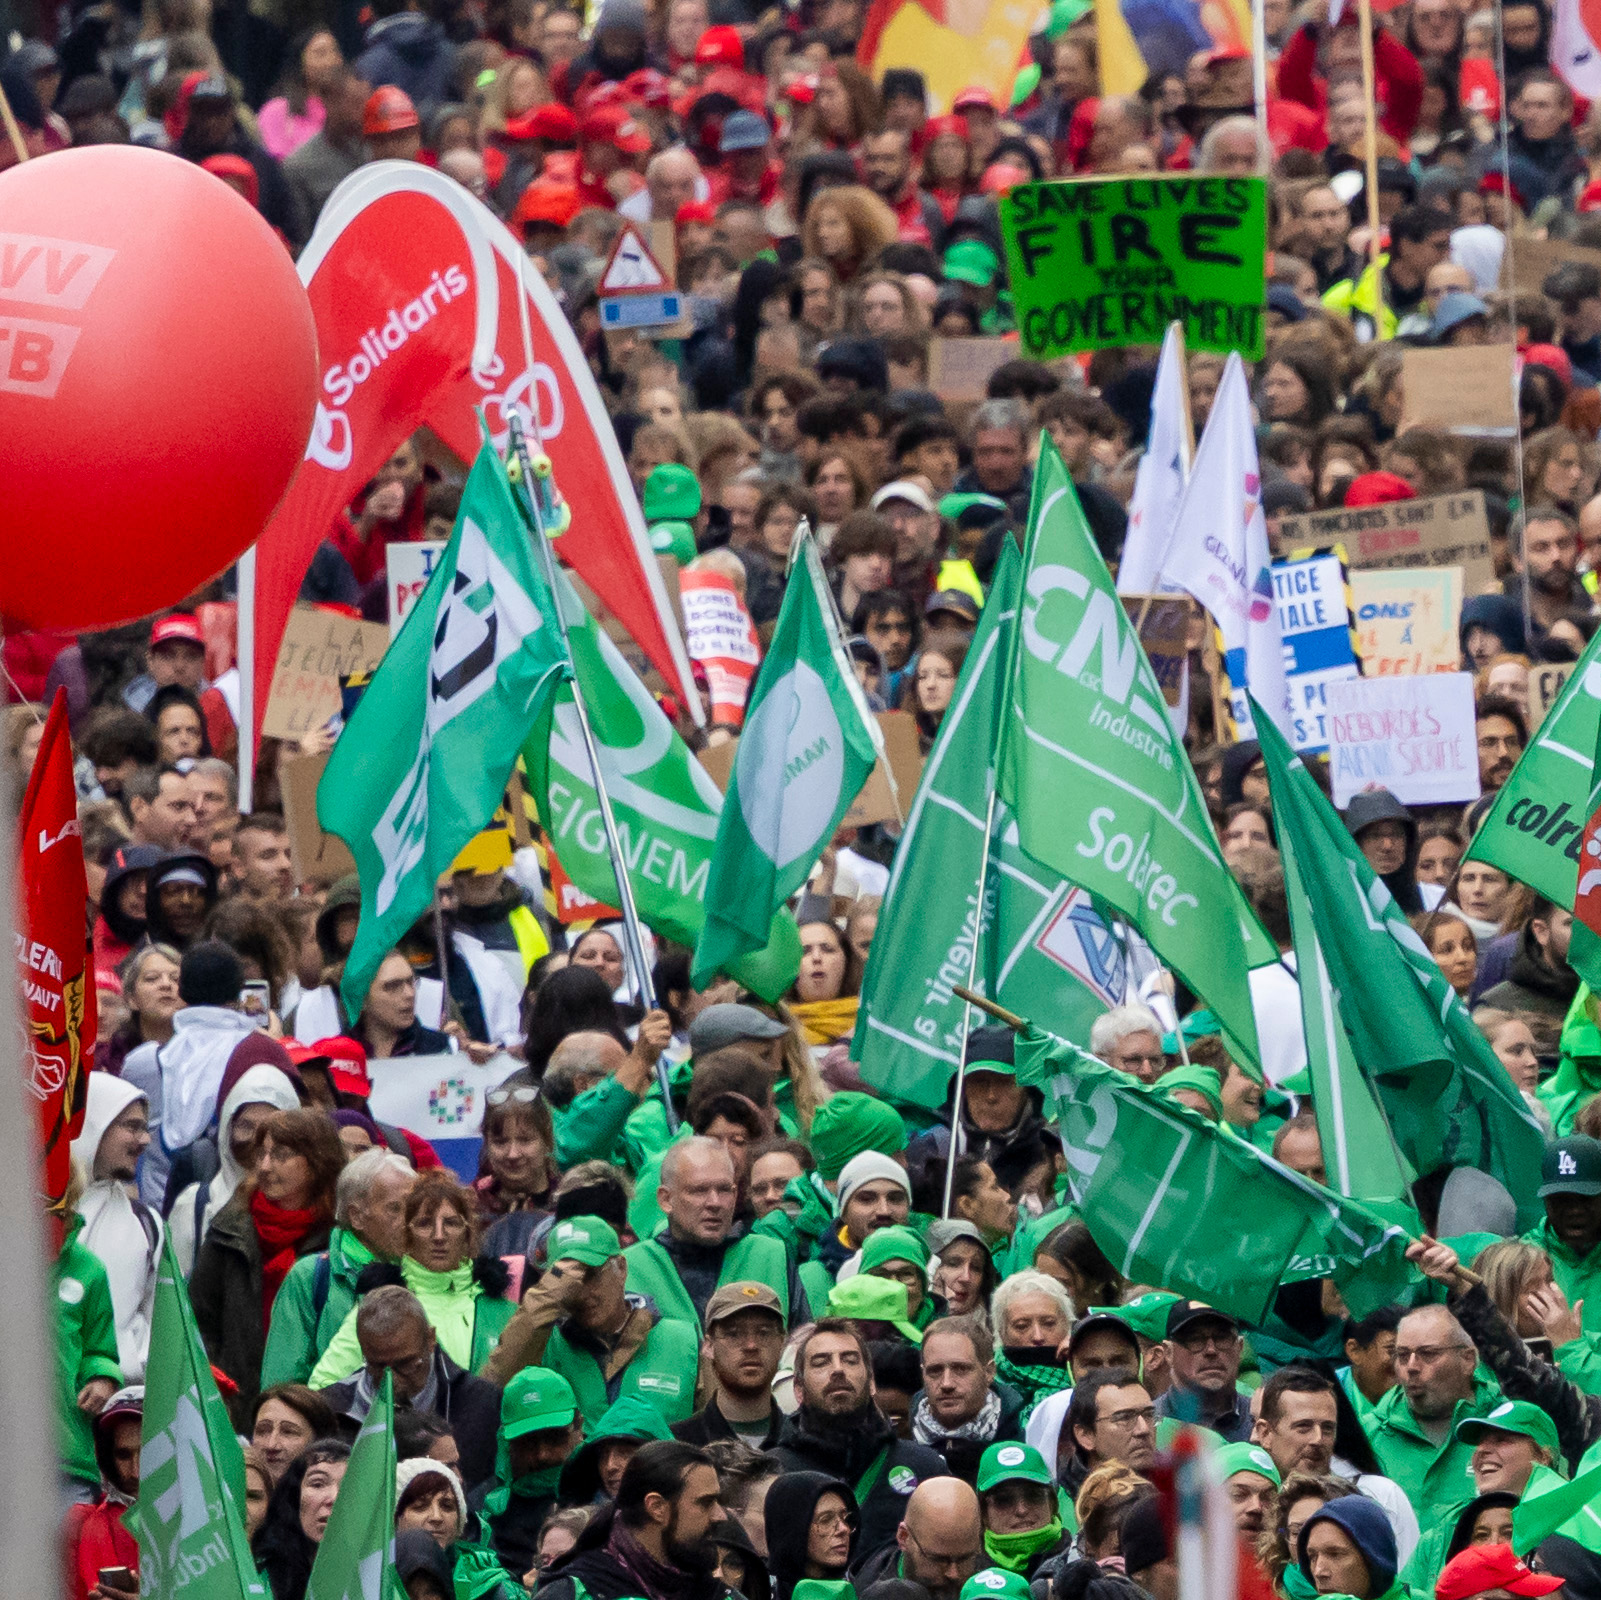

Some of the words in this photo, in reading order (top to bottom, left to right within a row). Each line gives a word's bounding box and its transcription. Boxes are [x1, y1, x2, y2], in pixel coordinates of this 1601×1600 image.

[1010, 181, 1106, 224] SAVE
[1123, 177, 1252, 214] LIVES
[1016, 212, 1244, 278] FIRE
[323, 264, 468, 406] Solidaris
[1024, 288, 1260, 354] GOVERNMENT
[1089, 703, 1173, 772] Industrie
[1076, 806, 1199, 927] Solarec
[1558, 1150, 1577, 1175] LA
